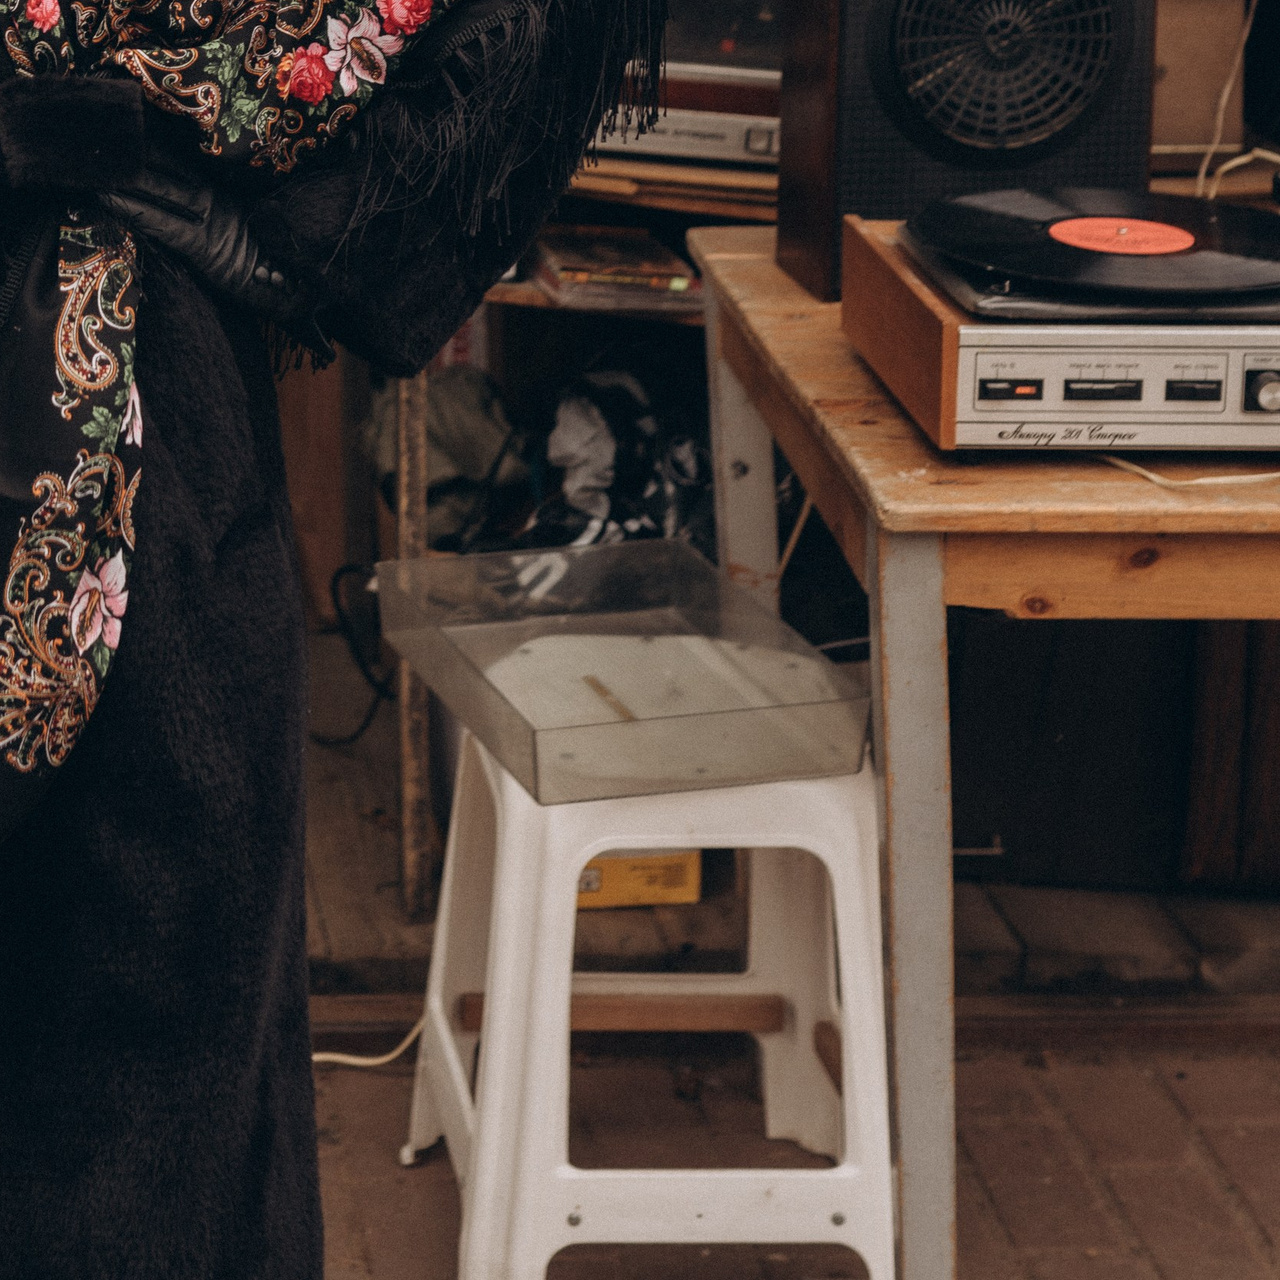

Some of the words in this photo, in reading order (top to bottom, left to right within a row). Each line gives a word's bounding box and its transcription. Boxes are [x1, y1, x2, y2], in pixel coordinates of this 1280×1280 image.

[998, 422, 1056, 447] Аккорд
[1061, 428, 1083, 440] 201
[1087, 424, 1138, 447] Стерео
